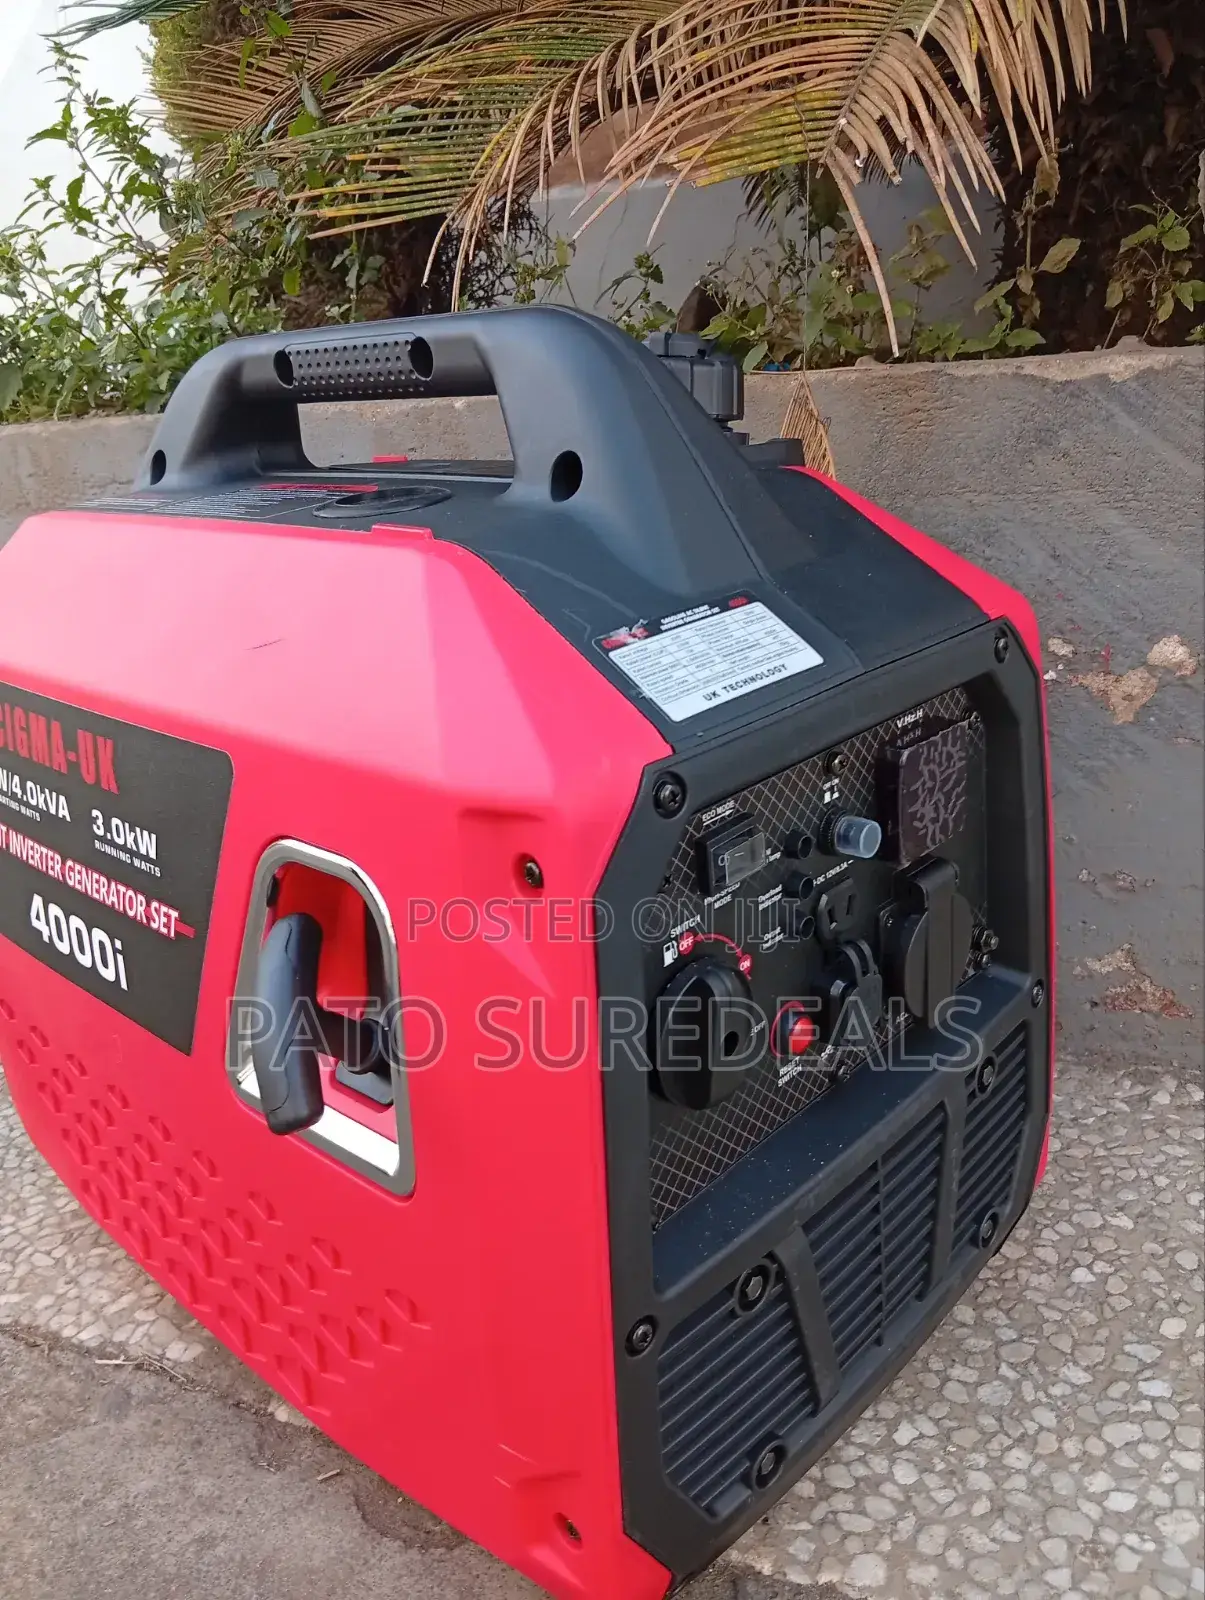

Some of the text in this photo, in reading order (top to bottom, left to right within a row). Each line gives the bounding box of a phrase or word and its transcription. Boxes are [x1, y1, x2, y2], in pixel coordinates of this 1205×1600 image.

[702, 690, 720, 702] UK
[721, 663, 788, 694] TECHNOLOGY
[20, 804, 41, 822] WATTS
[702, 800, 735, 821] ECO MODE
[92, 809, 157, 860] 3.0kW
[95, 839, 161, 877] RUNNING WATTS
[9, 827, 63, 881] INVERTER
[65, 860, 147, 925] GENERATOR
[150, 899, 180, 940] SET
[714, 893, 733, 909] MODE
[670, 914, 701, 938] SWITCH
[30, 893, 129, 991] 4000i
[679, 935, 695, 951] OFF
[739, 959, 751, 971] ON
[777, 1065, 802, 1088] SWITCH
[779, 1056, 801, 1077] RESET
